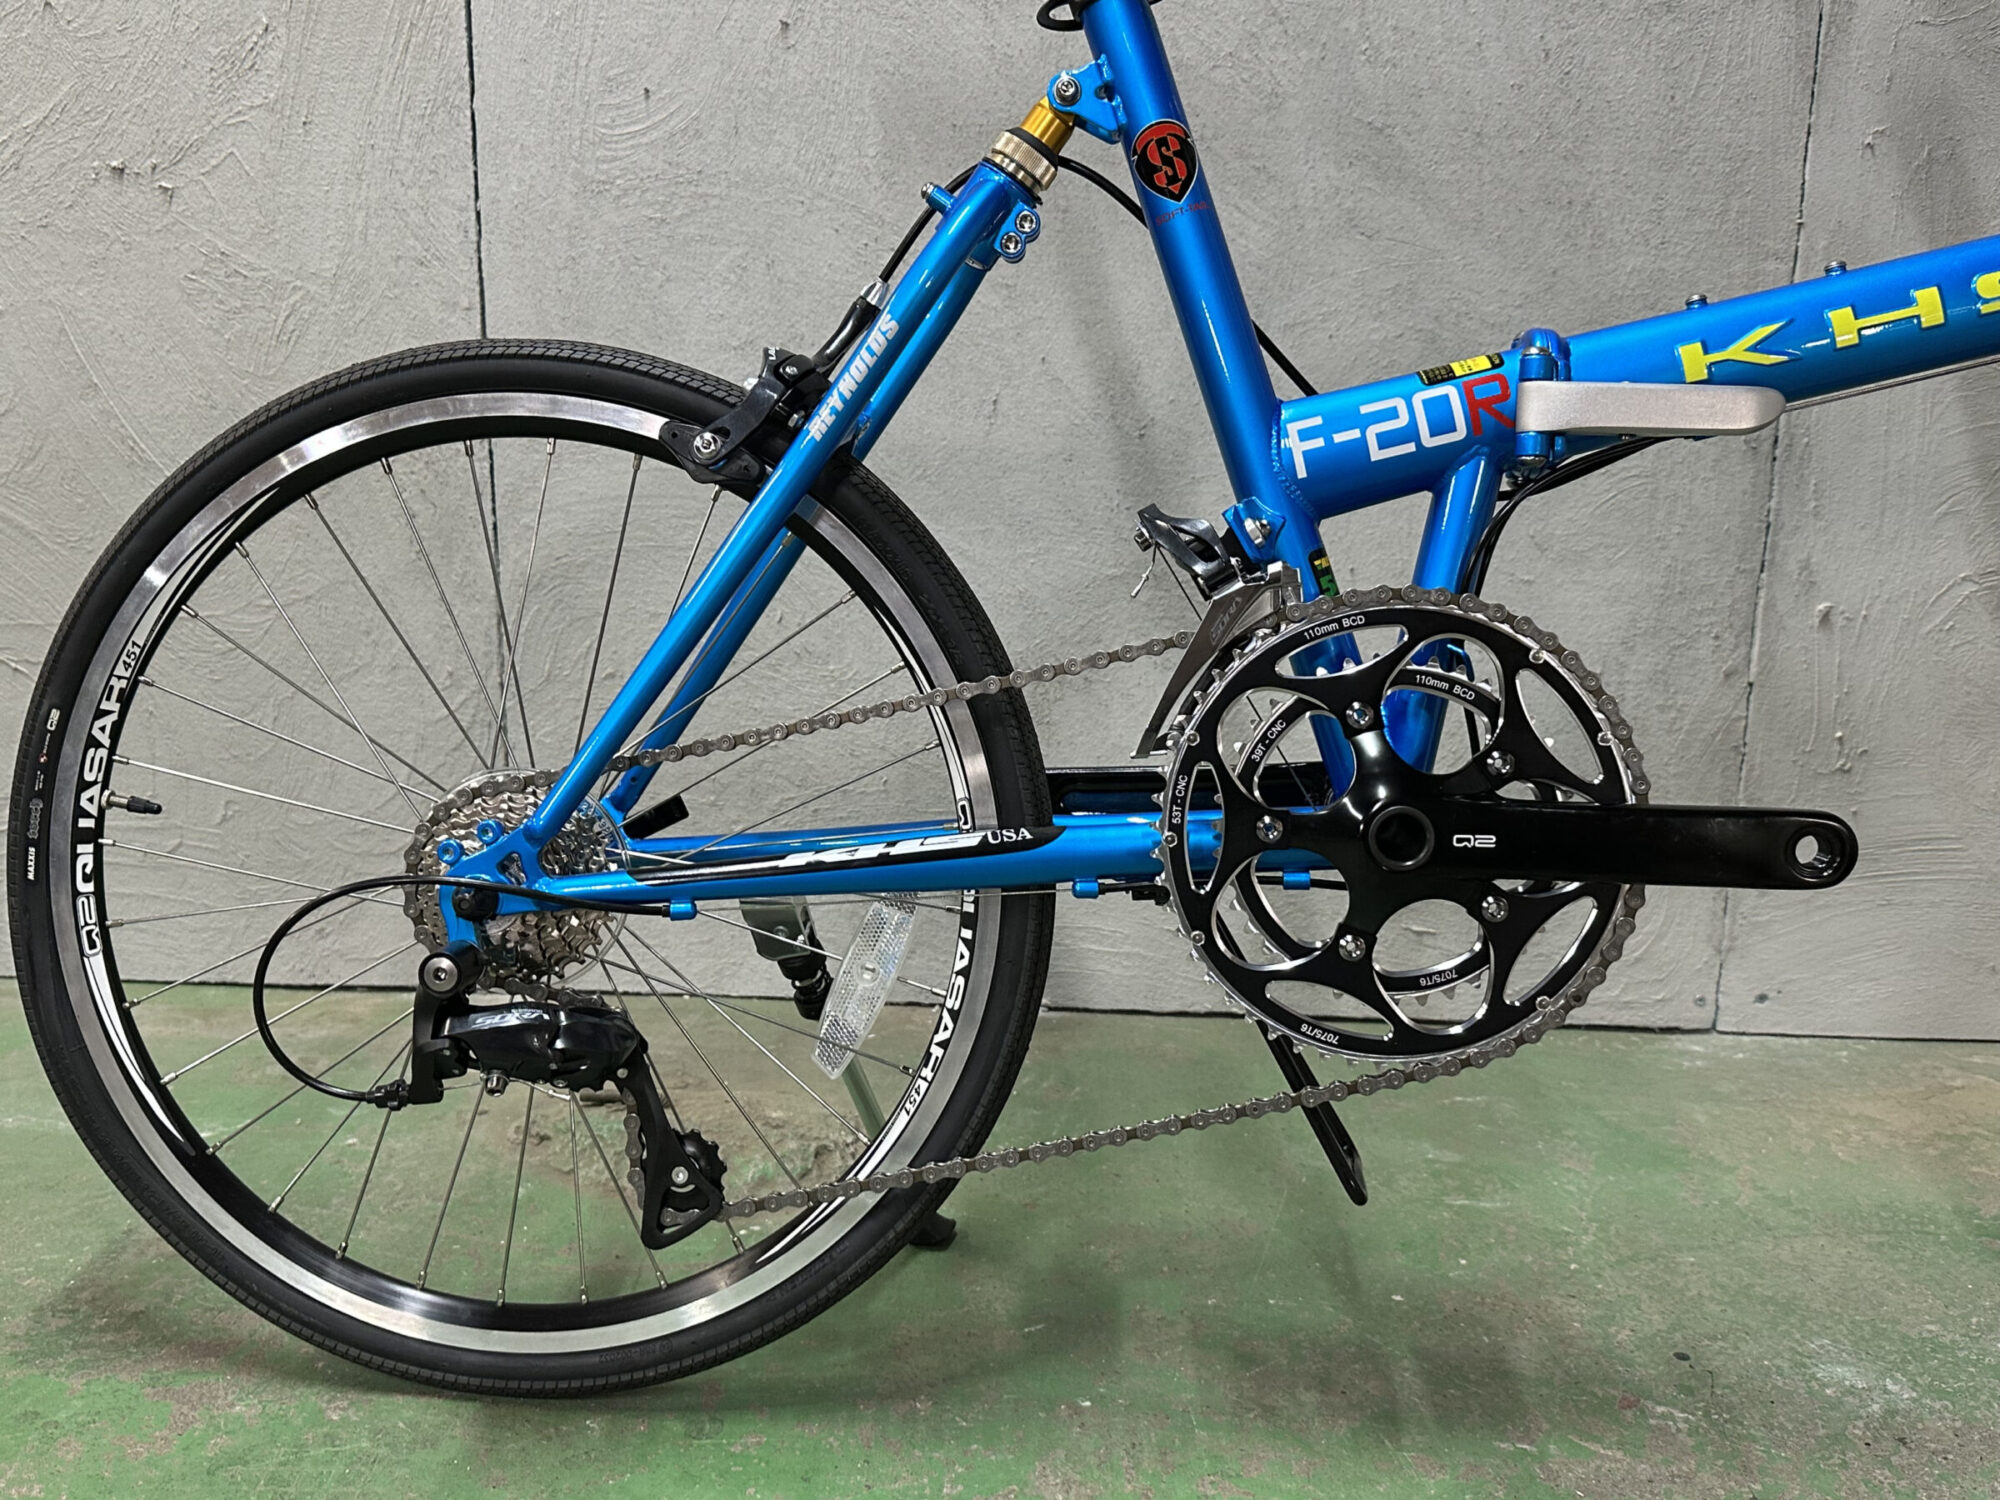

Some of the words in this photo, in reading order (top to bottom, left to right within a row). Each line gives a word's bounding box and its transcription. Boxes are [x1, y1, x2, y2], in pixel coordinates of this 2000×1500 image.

[1677, 270, 2000, 384] KH
[807, 313, 900, 442] REYNOLDS
[1286, 373, 1516, 480] F-20R
[1304, 622, 1340, 640] 110mm
[1342, 615, 1365, 627] BCD
[122, 640, 142, 674] 451
[1416, 674, 1449, 690] 110mm
[1453, 684, 1475, 700] BCD
[1251, 743, 1266, 762] 39T
[1267, 719, 1287, 739] CNC
[1175, 774, 1188, 797] CNC
[1171, 804, 1182, 824] 53T
[985, 827, 1034, 844] USA
[1452, 834, 1497, 848] Q2
[27, 846, 36, 881] MAXXIS
[1419, 968, 1459, 987] 7075/T6
[1300, 1023, 1340, 1045] 7075/T6
[904, 1083, 922, 1117] 451
